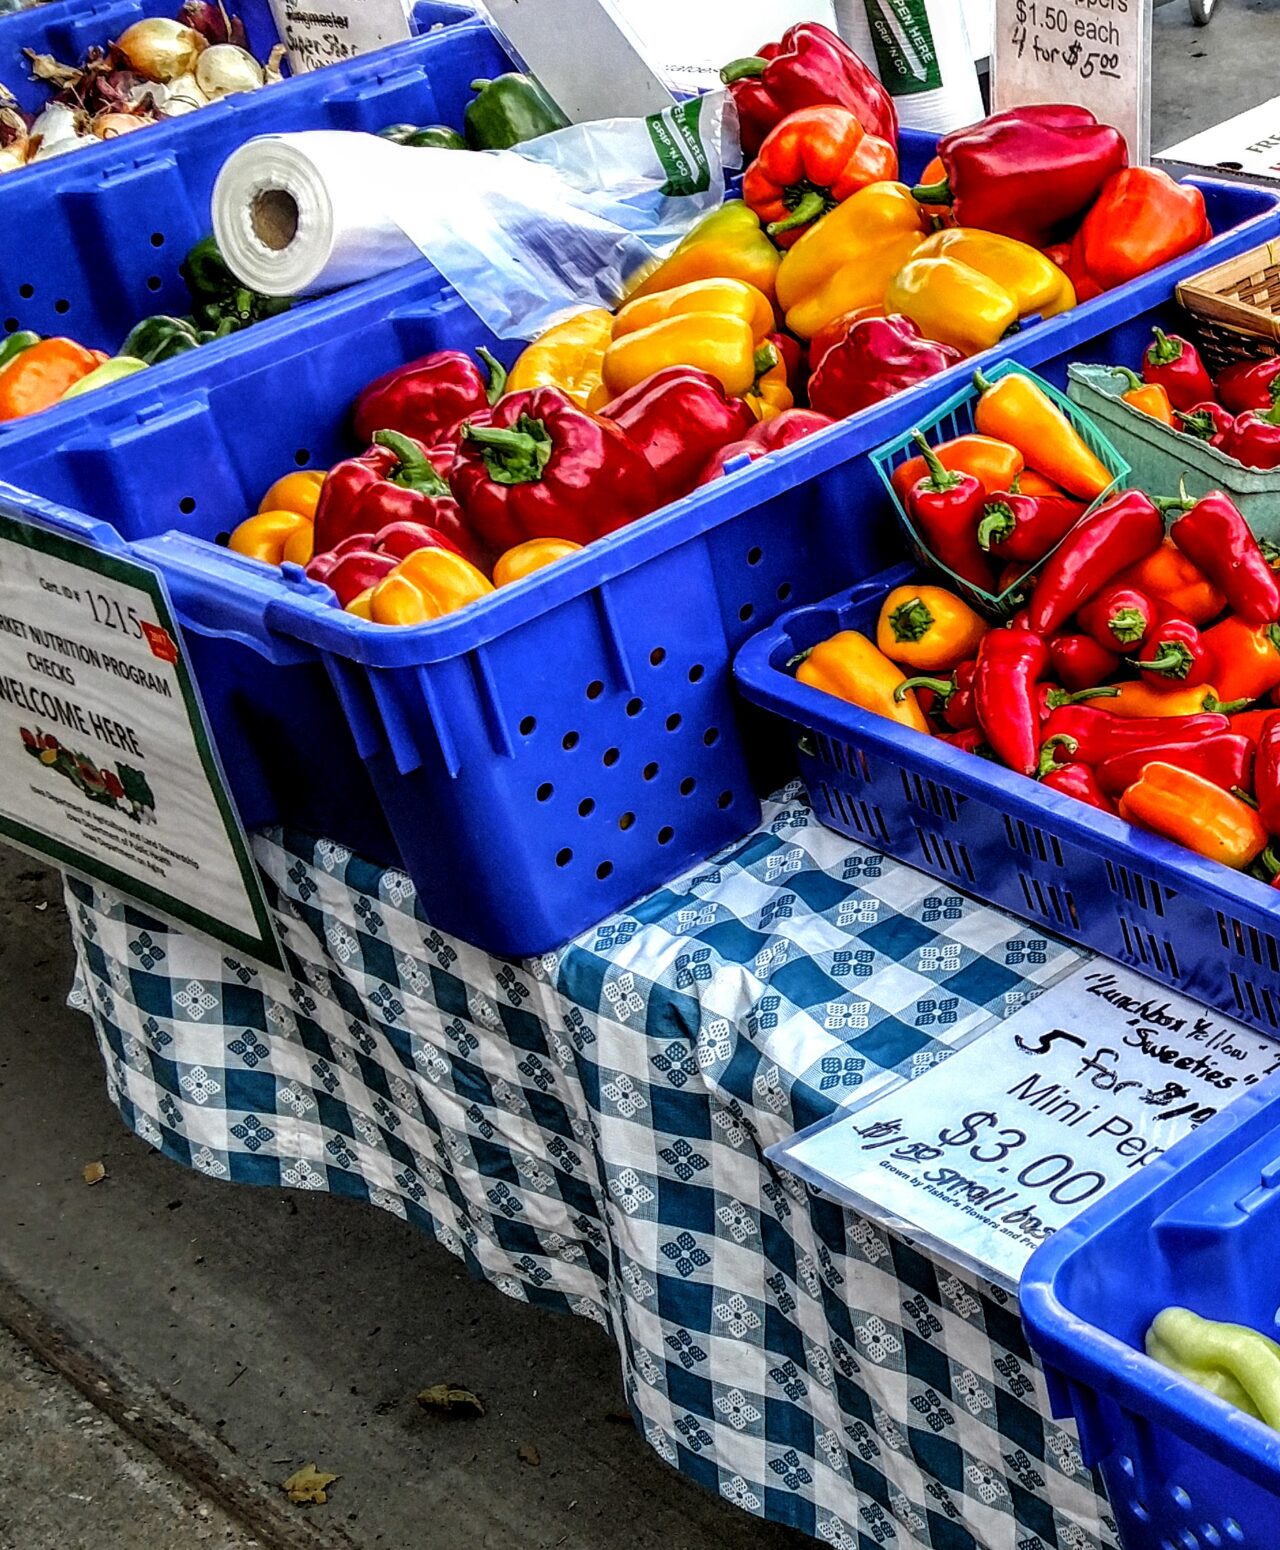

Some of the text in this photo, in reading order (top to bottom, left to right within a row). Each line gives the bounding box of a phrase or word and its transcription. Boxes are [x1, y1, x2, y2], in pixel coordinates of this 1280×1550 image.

[874, 20, 893, 46] GRIP
[909, 26, 934, 64] HERE
[1012, 26, 1027, 58] 4
[1016, 0, 1120, 46] $1.50 each
[652, 120, 671, 146] GRIP
[676, 160, 688, 177] GO
[681, 125, 705, 166] HERE
[86, 590, 143, 640] 1215
[27, 652, 75, 686] CHECKS
[29, 625, 102, 669] NUTRITION
[100, 653, 173, 698] PROGRAM
[88, 710, 145, 759] HERE
[1014, 1029, 1088, 1056] 5
[1075, 1047, 1144, 1096] for
[1006, 1072, 1101, 1127] Mini
[937, 1111, 1107, 1206] $3.00
[879, 1160, 911, 1181] Grown
[911, 1172, 924, 1188] by
[922, 1183, 961, 1208] Fisher's
[960, 1204, 1001, 1230] Flowers
[999, 1226, 1024, 1241] and
